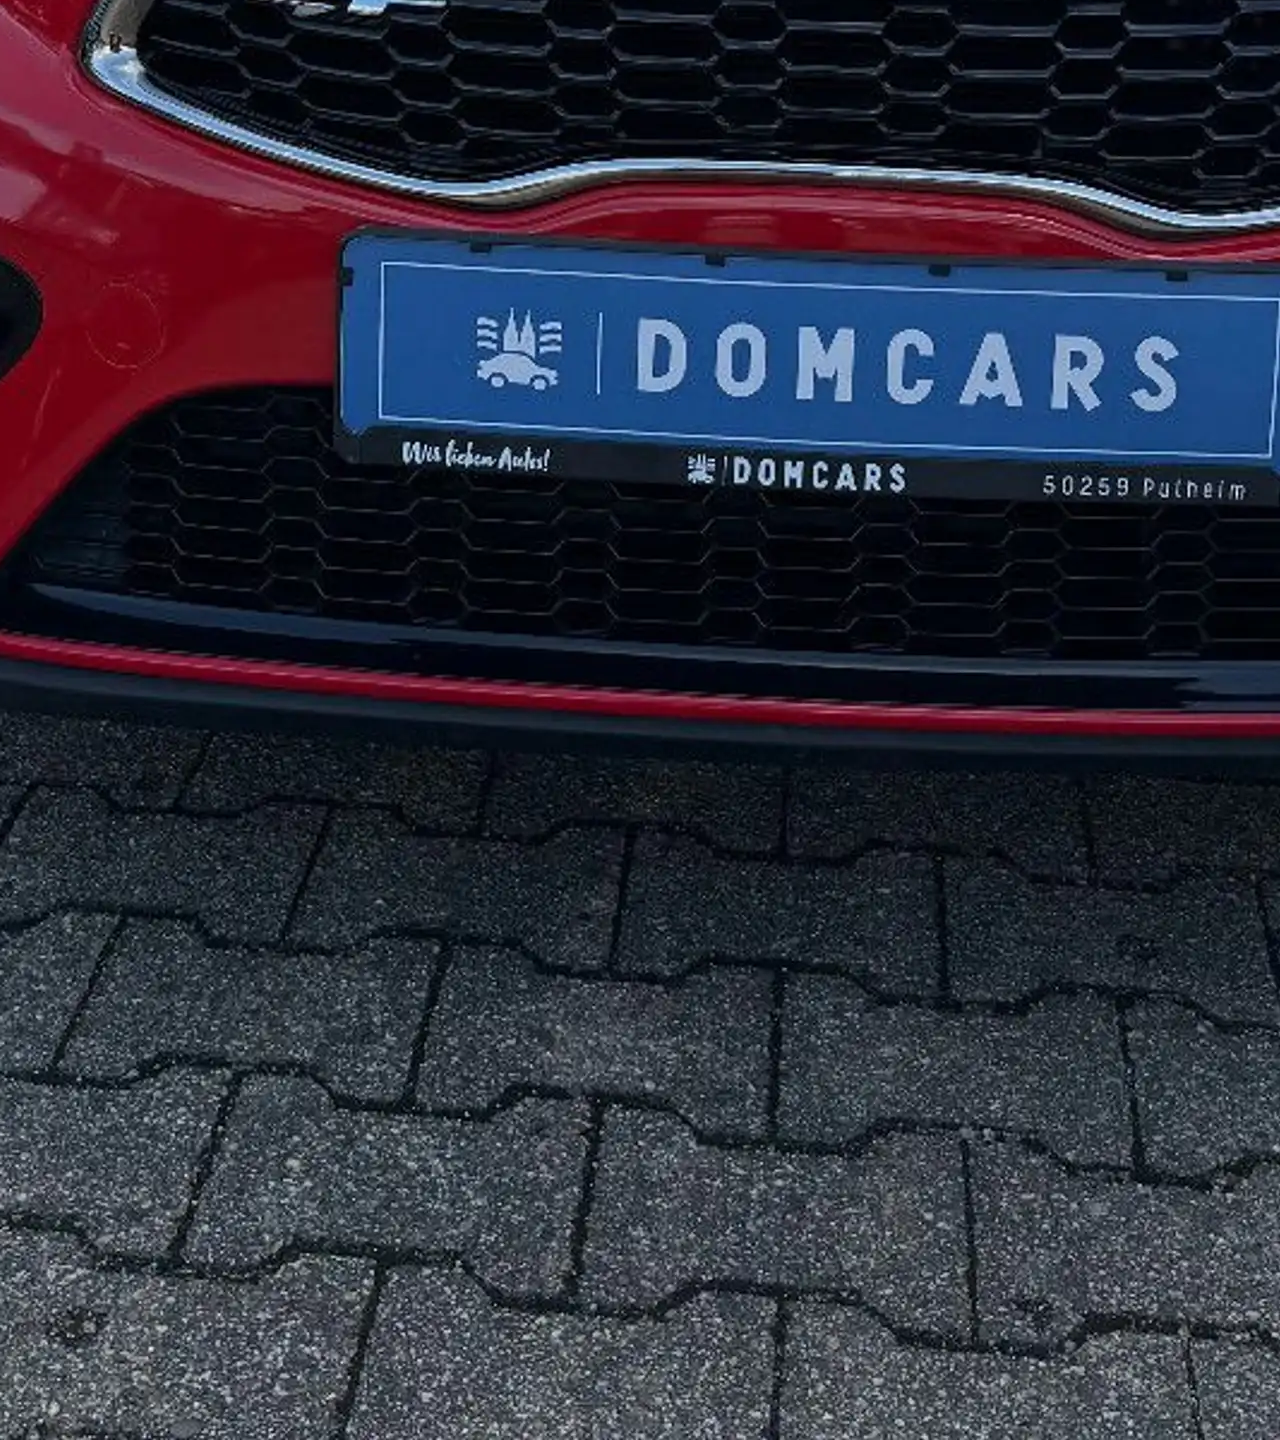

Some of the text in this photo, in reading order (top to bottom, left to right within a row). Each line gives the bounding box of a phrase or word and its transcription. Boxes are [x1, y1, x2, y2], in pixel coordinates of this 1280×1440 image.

[637, 317, 1180, 412] DOMCARS
[732, 455, 907, 494] DOMCARS
[1042, 474, 1247, 501] 50259 Pulheim
